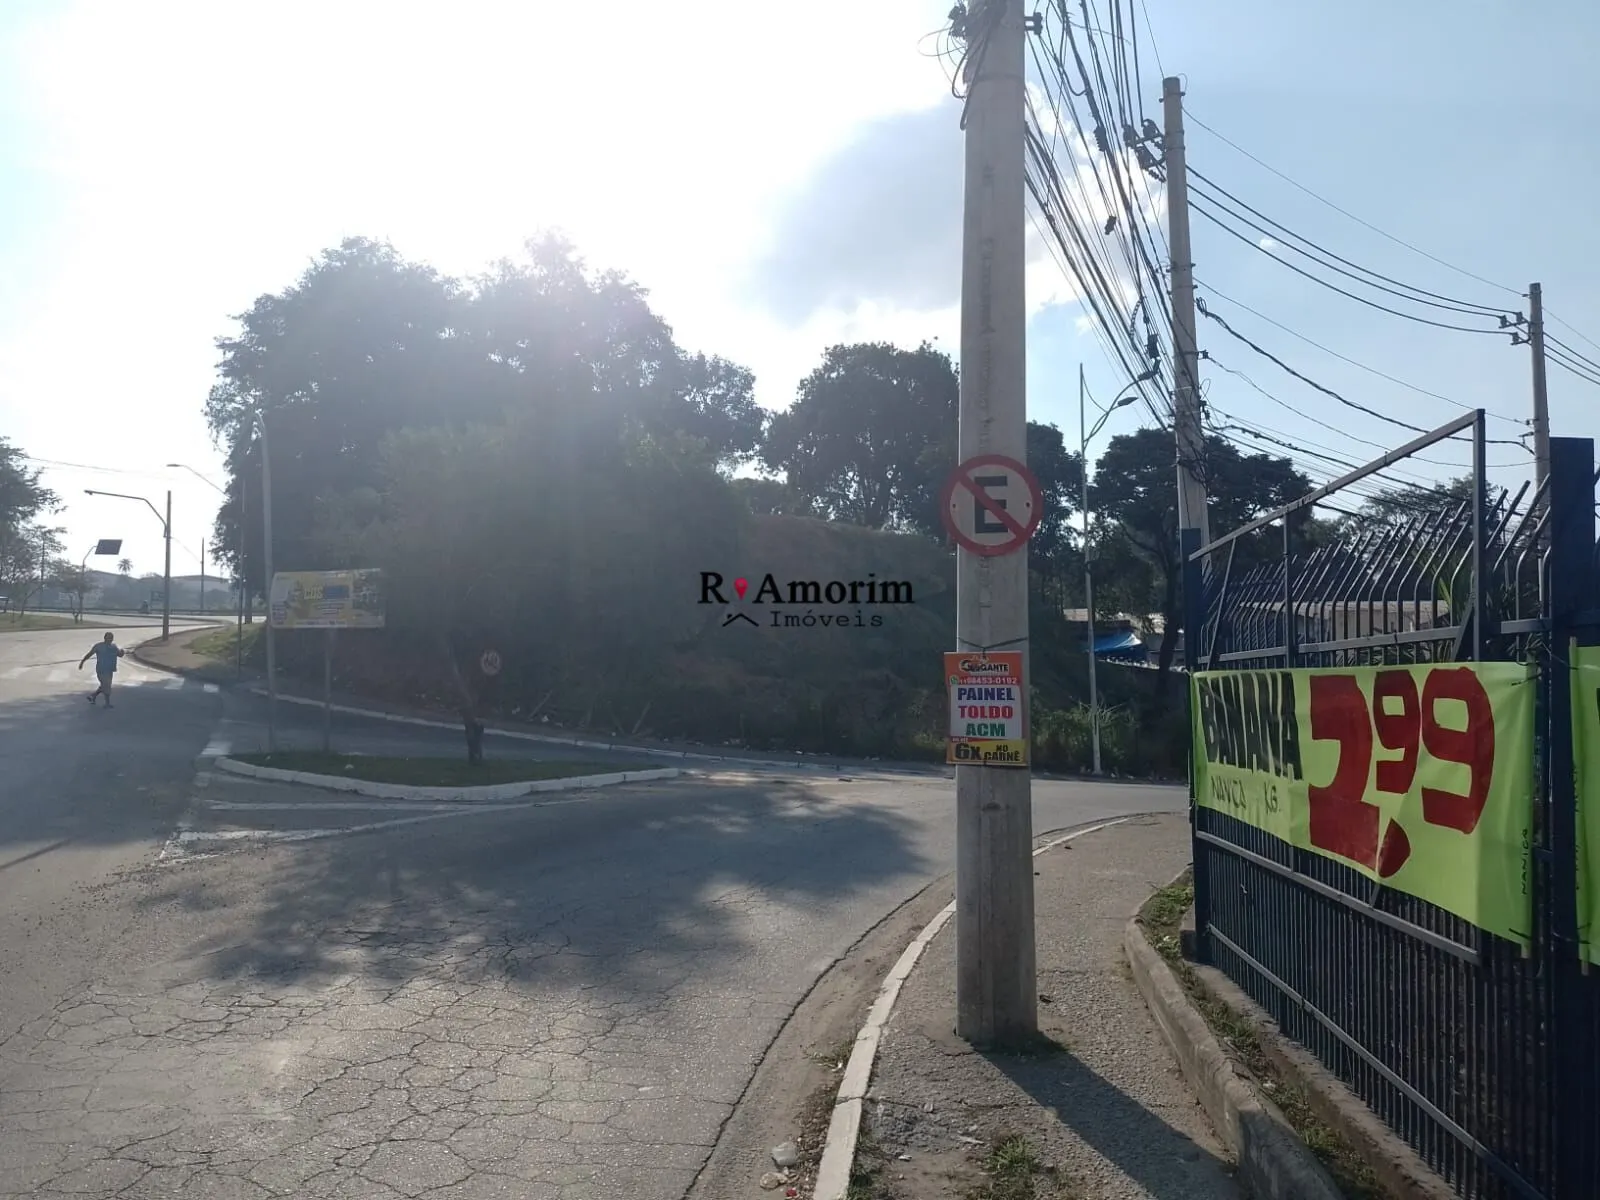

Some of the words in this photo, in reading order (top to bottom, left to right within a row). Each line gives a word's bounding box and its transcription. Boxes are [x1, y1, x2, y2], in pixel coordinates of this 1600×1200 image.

[974, 475, 1008, 534] E
[957, 687, 1016, 701] PAINEL
[958, 705, 1014, 719] TOLDO
[965, 723, 1006, 737] ACM
[1200, 671, 1303, 780] BANANA
